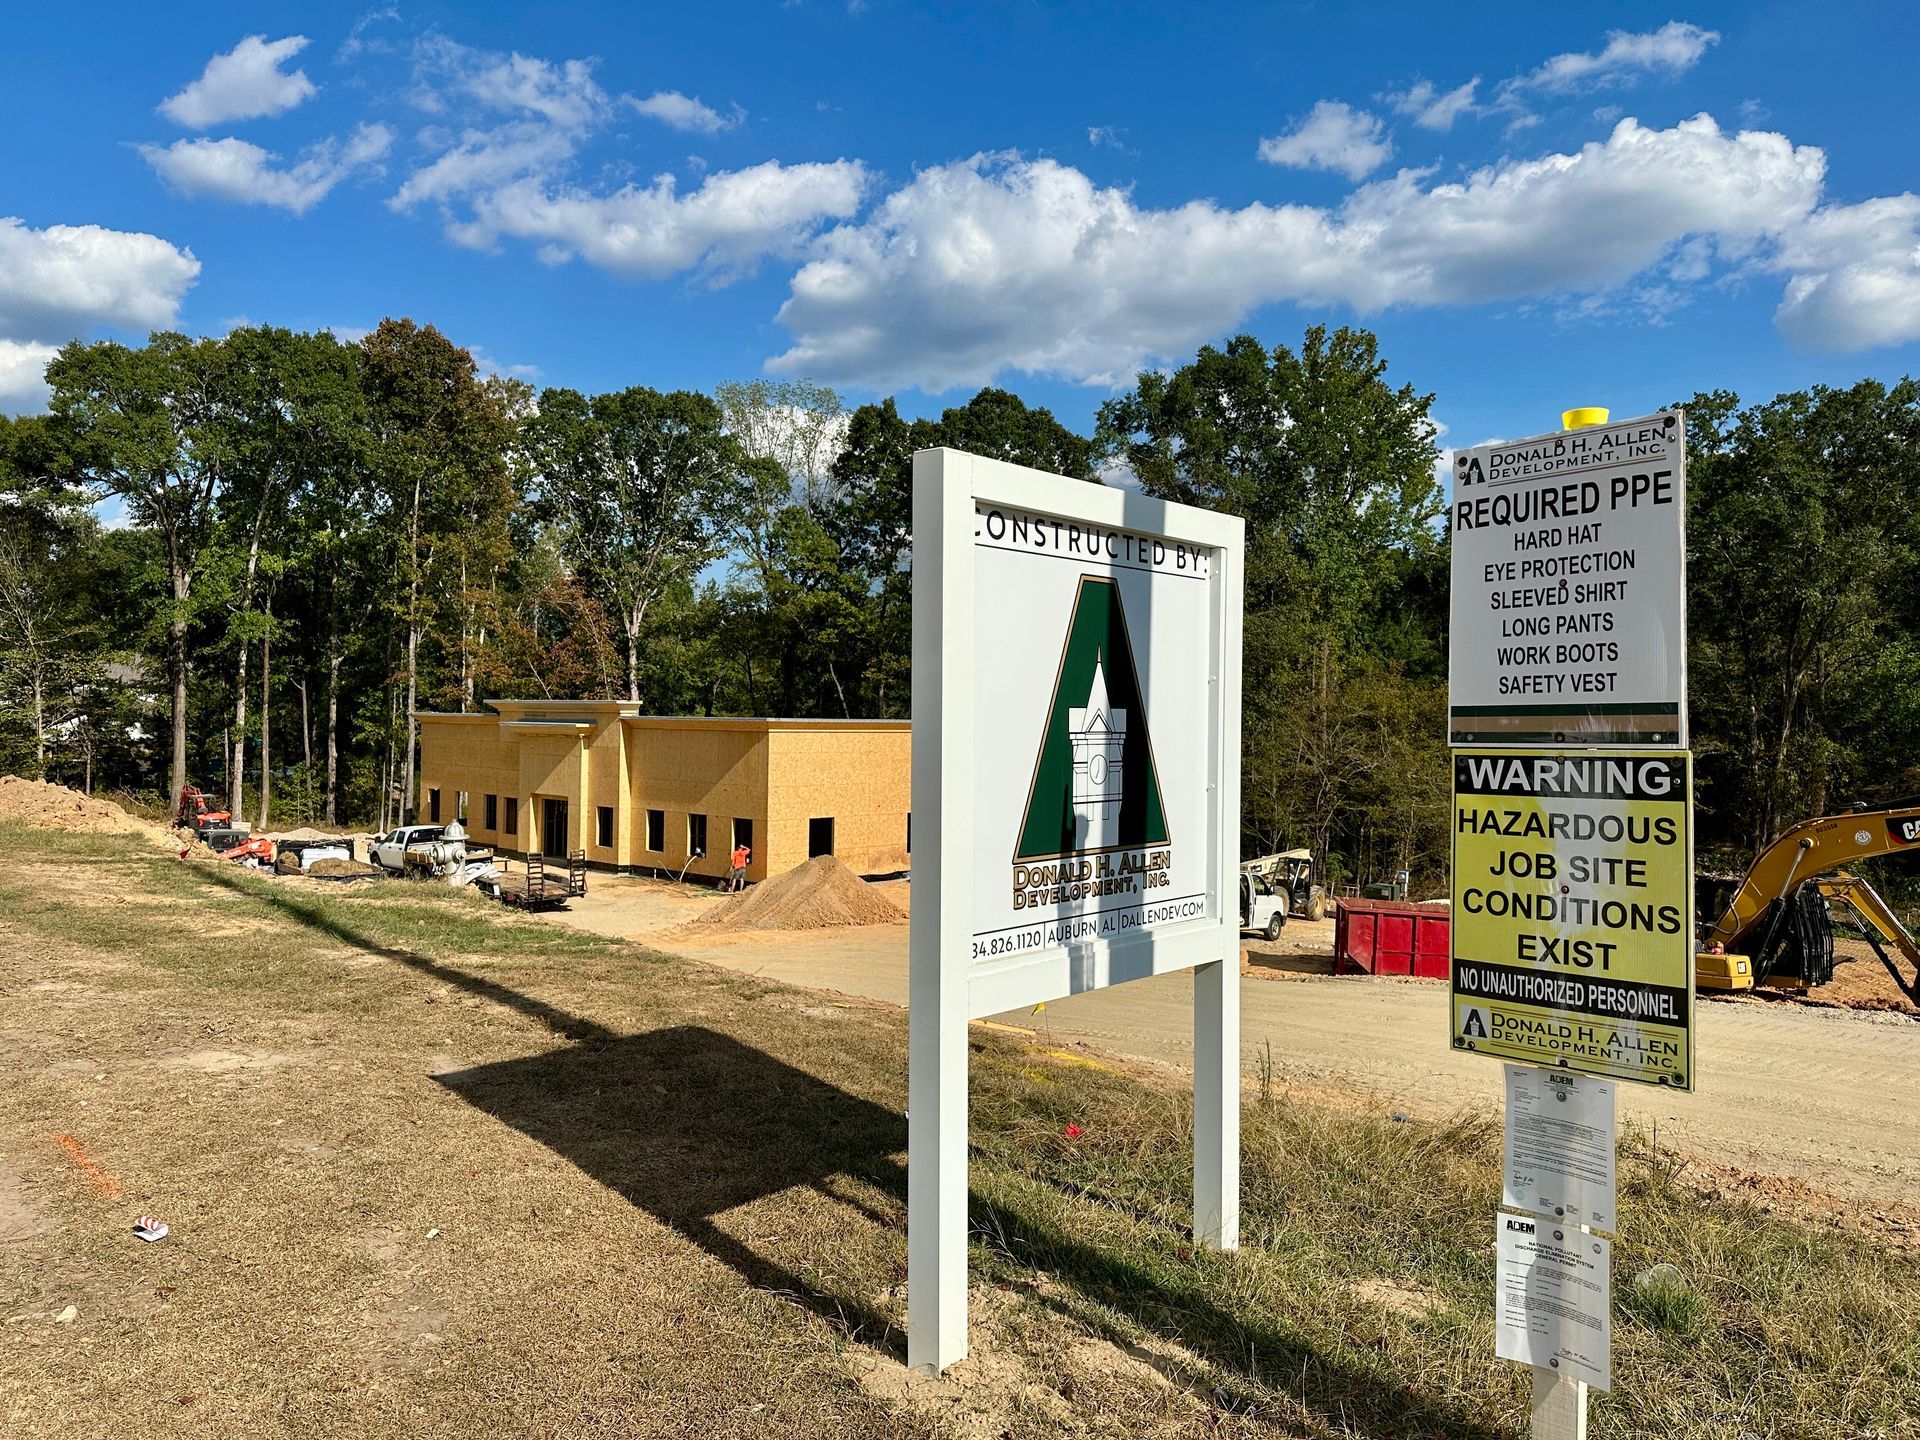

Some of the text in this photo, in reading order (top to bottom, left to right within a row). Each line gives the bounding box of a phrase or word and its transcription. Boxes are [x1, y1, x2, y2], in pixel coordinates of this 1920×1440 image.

[1489, 443, 1665, 480] DEVELOPMENT, INC.
[1490, 427, 1666, 468] DONALD H. ALLEN
[1457, 470, 1672, 531] REQUIRED PPE
[975, 507, 1208, 573] ONSTRUCTED BY:
[1514, 523, 1602, 551] HARD HAT
[1484, 550, 1635, 582] EYE PROTECTION
[1491, 581, 1628, 610] SLEEVED SHIRT
[1502, 612, 1614, 638] LONG PANTS
[1497, 642, 1619, 666] WORK BOOTS
[1499, 672, 1617, 694] SAFETY VEST
[1468, 758, 1671, 795] WARNING
[1458, 808, 1677, 845] HAZARDOUS
[1013, 850, 1171, 890] DONALD H. ALLEN
[1489, 851, 1647, 888] JOB SITE
[1013, 871, 1170, 910] DEVELOPMENT, INC.
[1047, 920, 1100, 944] AUBURN,
[1102, 918, 1116, 932] AL
[1121, 900, 1204, 929] DALLENDEV.COM
[1463, 888, 1681, 934] CONDITIONS
[1517, 933, 1617, 970] EXIST
[1459, 966, 1679, 1020] NO UNAUTHORIZED PERSONNEL
[1491, 1012, 1678, 1057] DONALD H. ALLEN
[1491, 1028, 1678, 1070] DEVELOPMENT, INC.
[1549, 1074, 1573, 1086] ADEM
[1506, 1220, 1535, 1234] ADEM
[1528, 1241, 1554, 1252] NATIONAL
